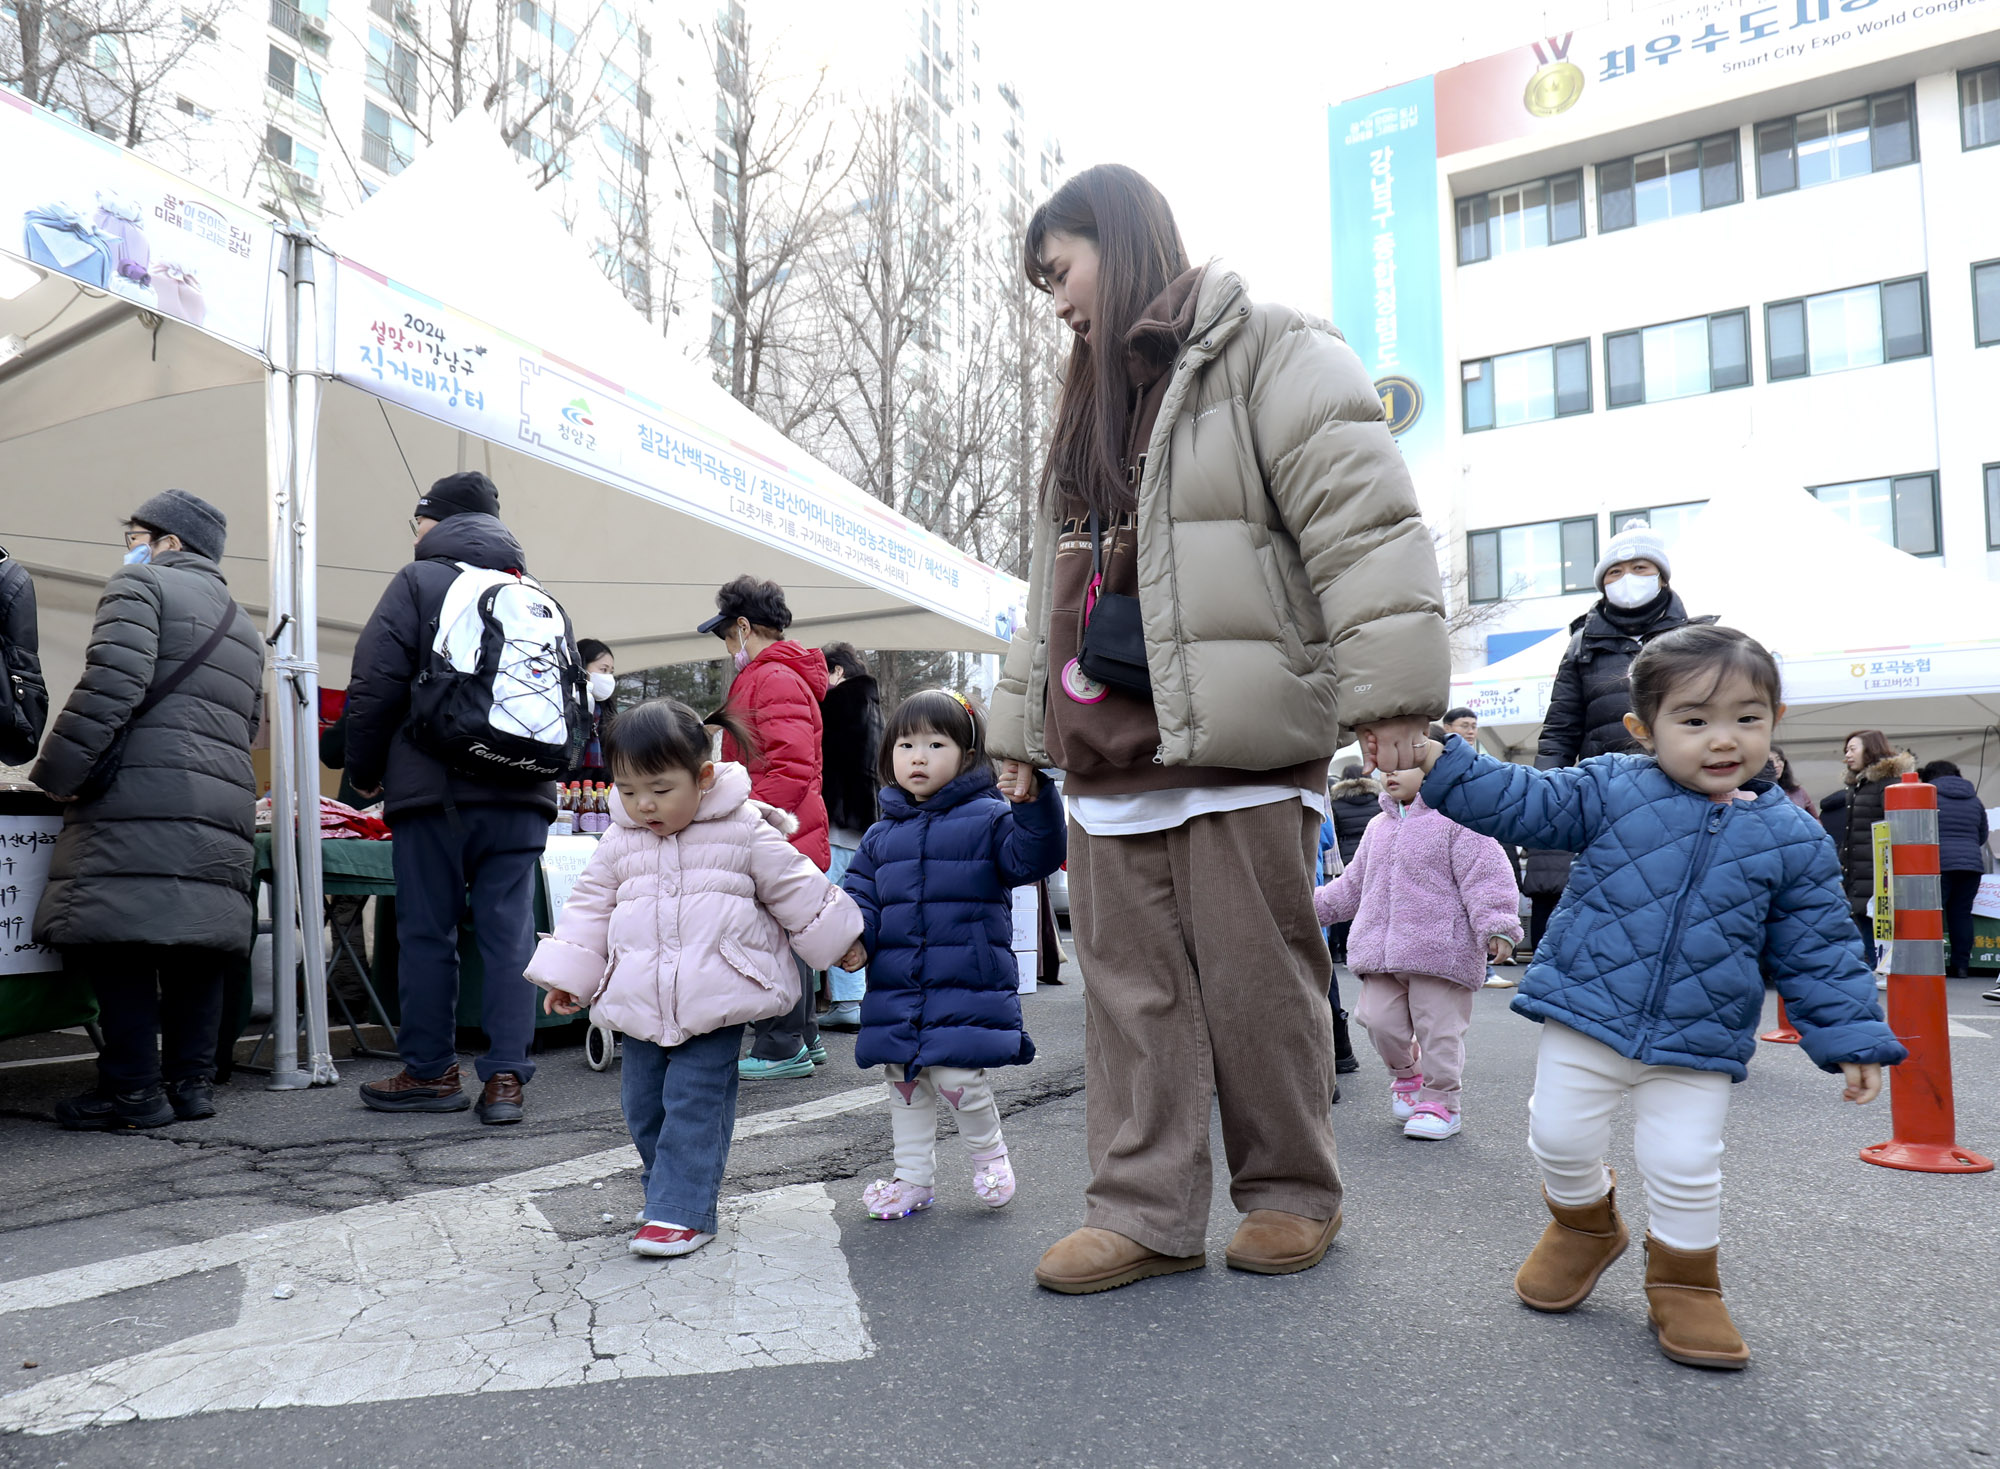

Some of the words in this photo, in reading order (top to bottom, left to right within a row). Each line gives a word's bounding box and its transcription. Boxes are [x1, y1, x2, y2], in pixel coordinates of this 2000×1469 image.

[1722, 52, 1769, 74] Smart
[1774, 44, 1805, 59] City
[1811, 30, 1852, 49] Expo
[1857, 11, 1906, 35] World
[1369, 144, 1396, 229] 강남구
[228, 239, 251, 259] 강남
[229, 225, 252, 245] 도시
[404, 313, 446, 342] 2024
[359, 345, 484, 411] 직거래장터
[558, 423, 597, 452] 청양군
[637, 423, 747, 493] 칠갑산백곡농원
[760, 478, 917, 569] 칠갑산어머니한과영농조합법인
[924, 556, 960, 589] 혜선식품
[1060, 541, 1075, 550] THE
[1869, 657, 1931, 674] 포곡농협
[1474, 705, 1520, 718] 거래장터
[468, 741, 511, 763] Team
[508, 757, 560, 774] Korea
[0, 857, 18, 876] 우
